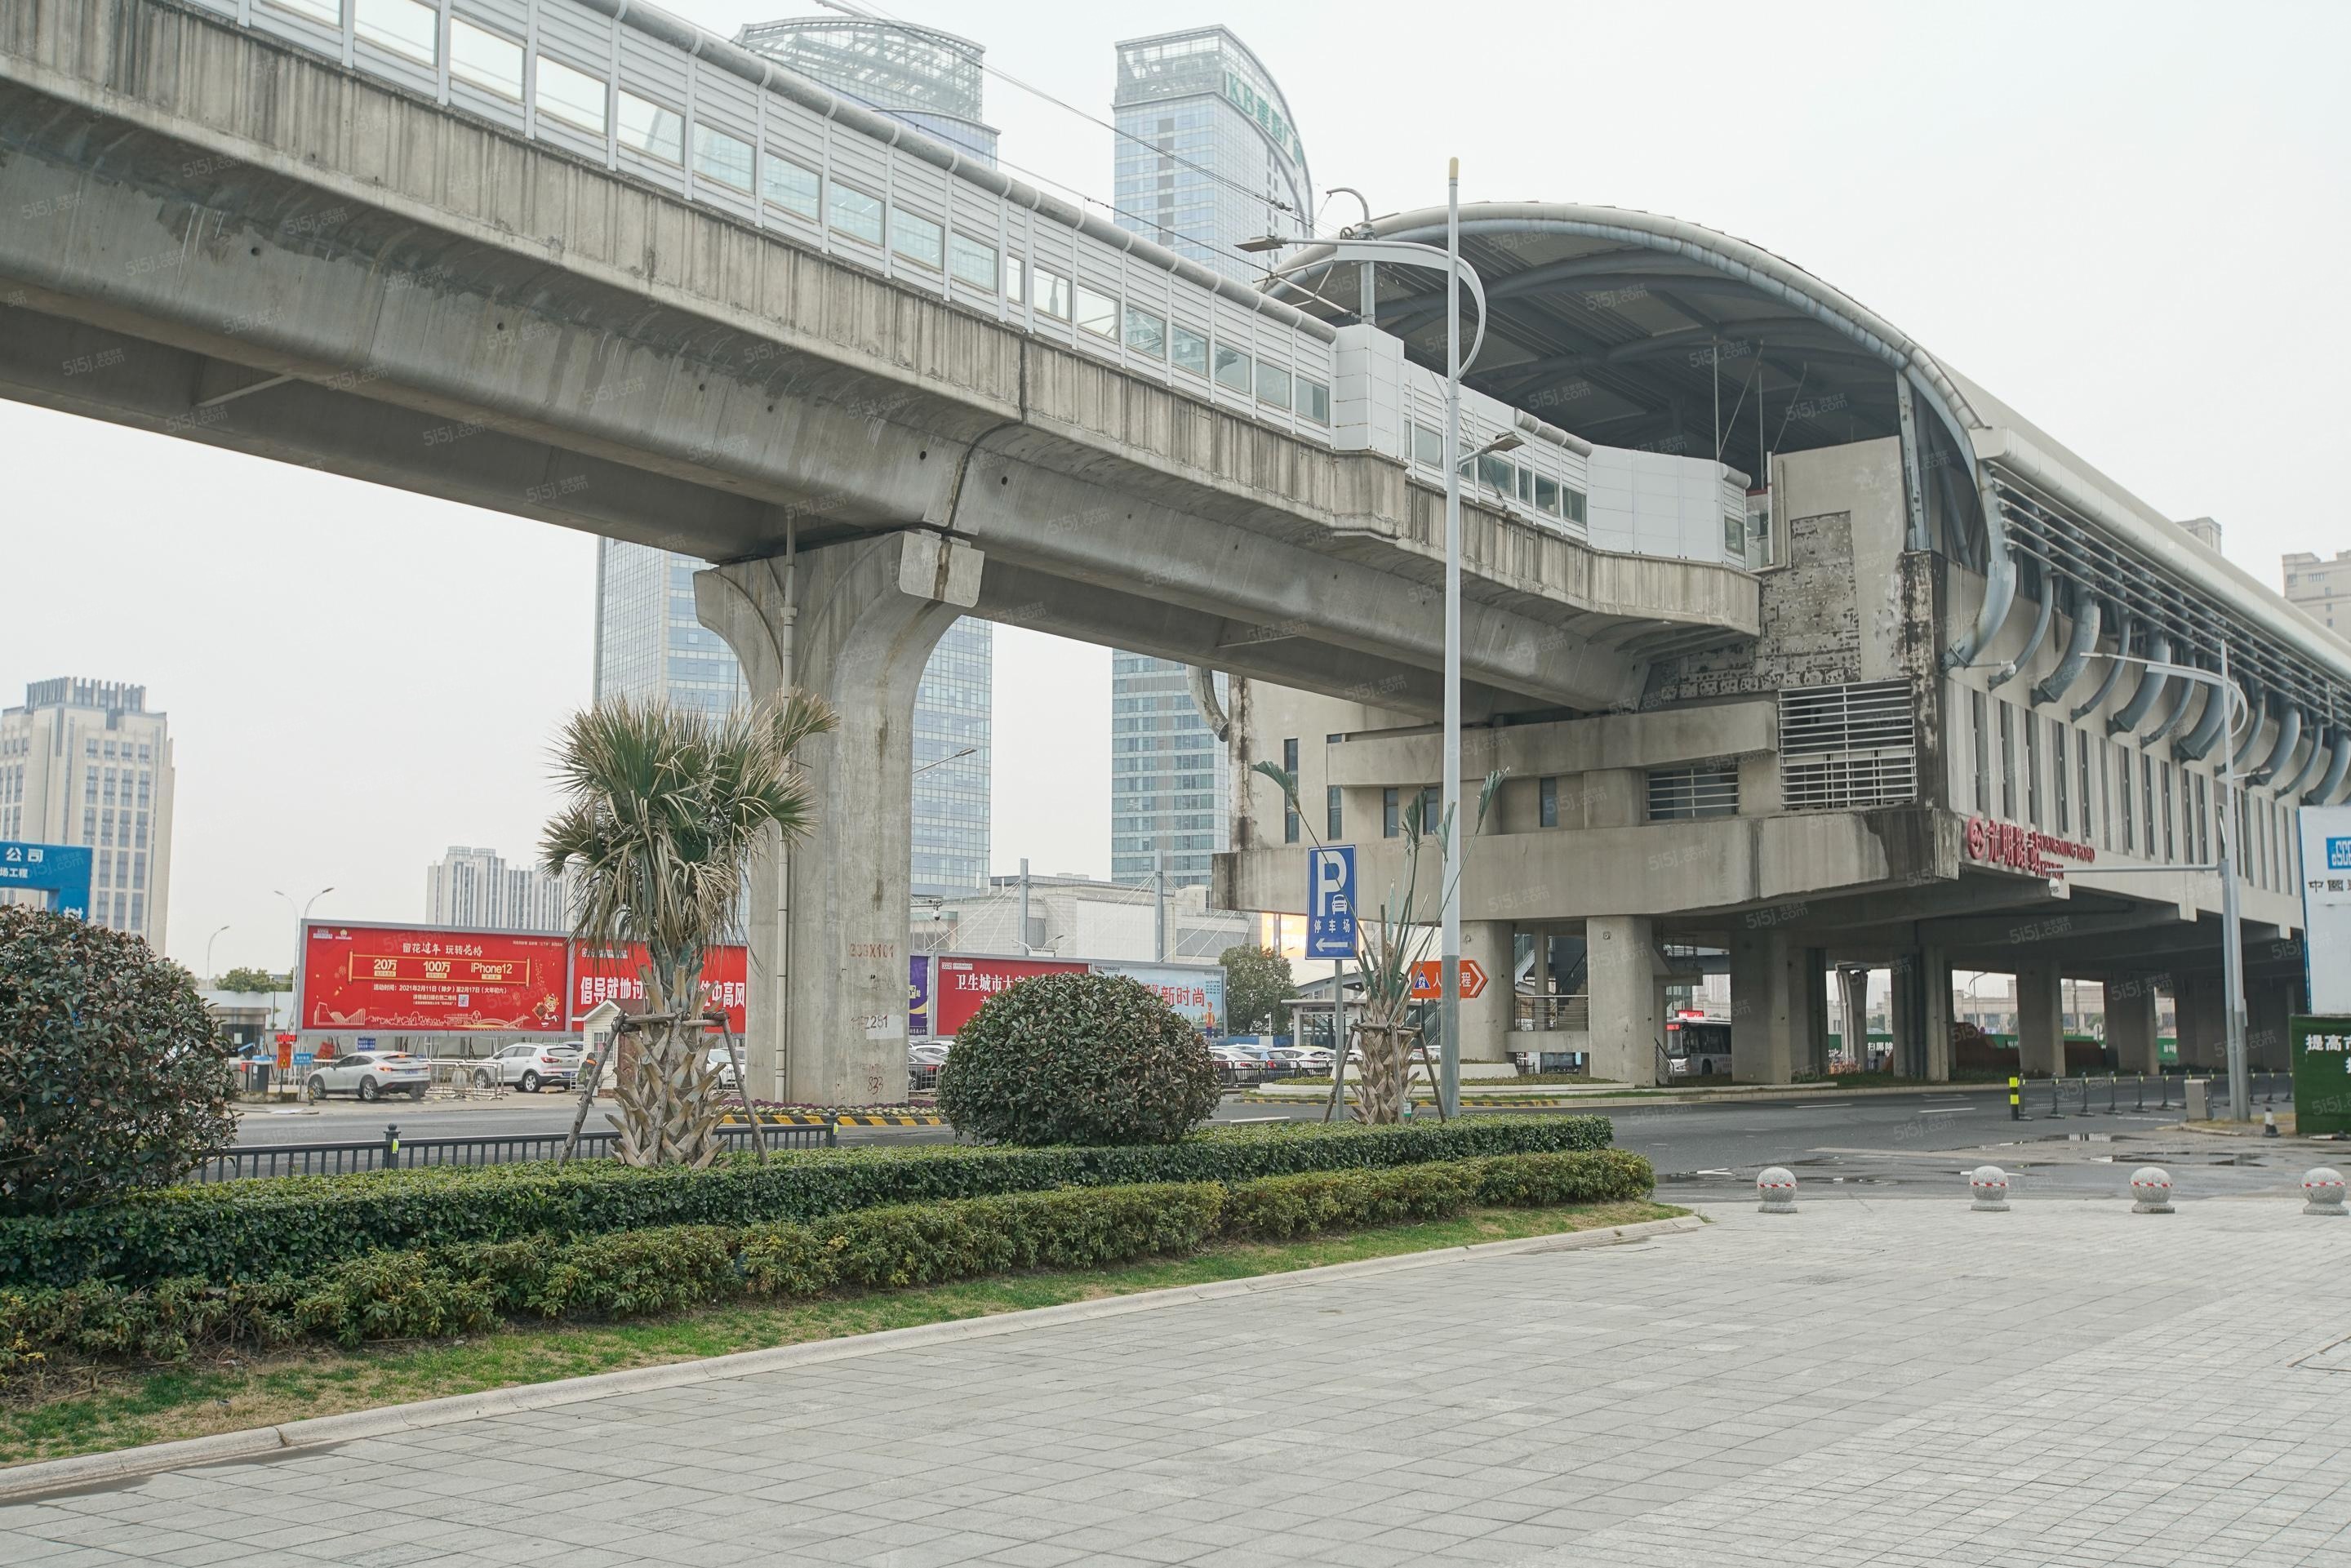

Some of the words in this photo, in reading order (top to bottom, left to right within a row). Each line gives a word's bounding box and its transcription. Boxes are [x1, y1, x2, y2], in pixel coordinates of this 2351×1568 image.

[1986, 820, 2040, 872] 光明路站
[6, 846, 44, 863] 公司
[1317, 850, 1348, 917] P
[1313, 918, 1351, 934] 停车场
[374, 958, 398, 971] 20万
[423, 961, 451, 973] 100万
[470, 962, 513, 975] iPhone12
[1433, 971, 1471, 988] 人程
